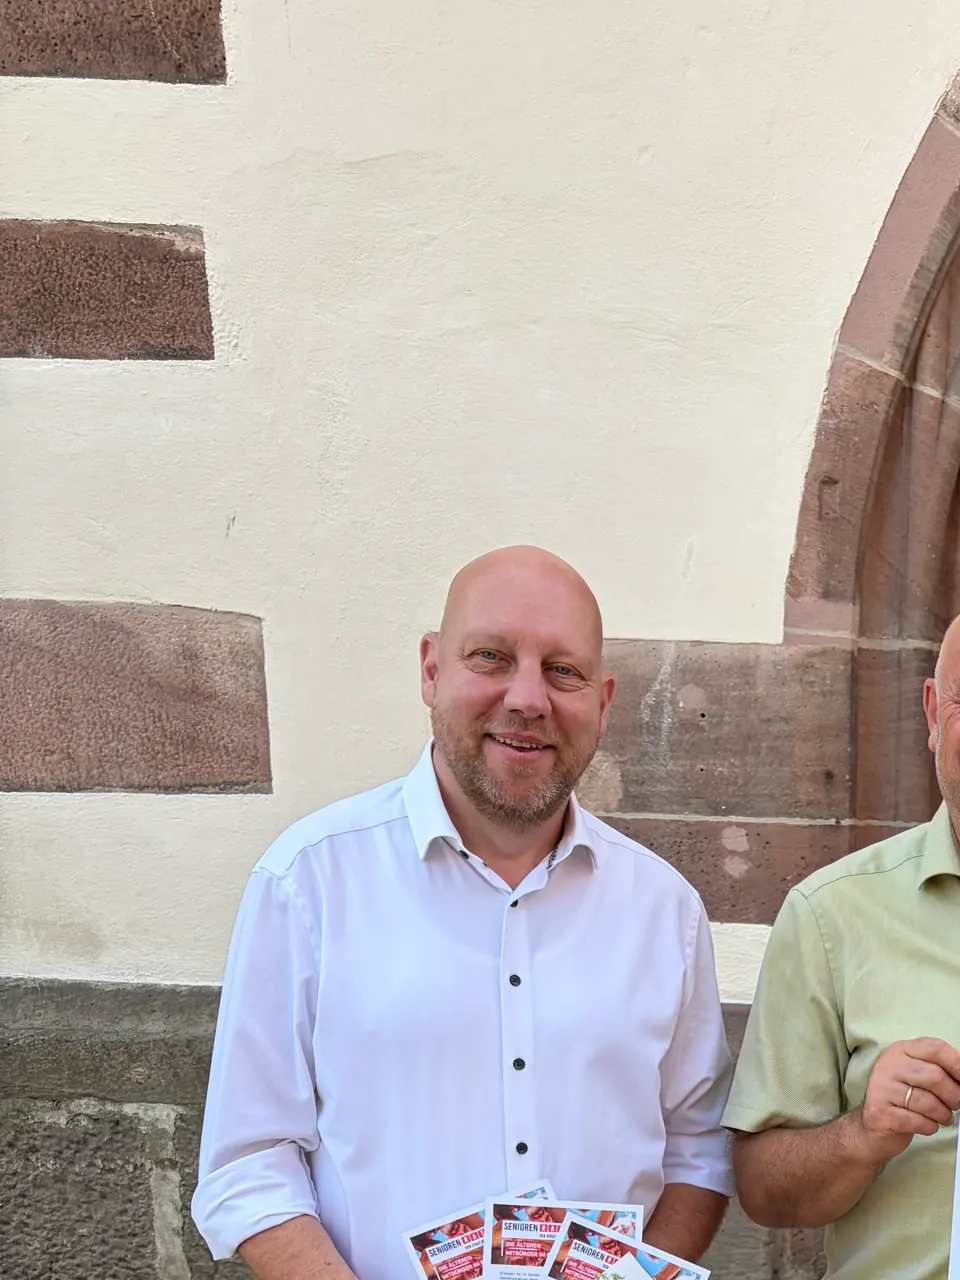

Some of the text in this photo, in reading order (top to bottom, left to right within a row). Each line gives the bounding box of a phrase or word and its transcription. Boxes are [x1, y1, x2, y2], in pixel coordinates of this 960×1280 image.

[504, 1222, 538, 1232] SENIOREN
[429, 1239, 461, 1257] SENIOREN
[573, 1243, 605, 1261] SENIOREN
[449, 1255, 472, 1268] ÄLTEREN
